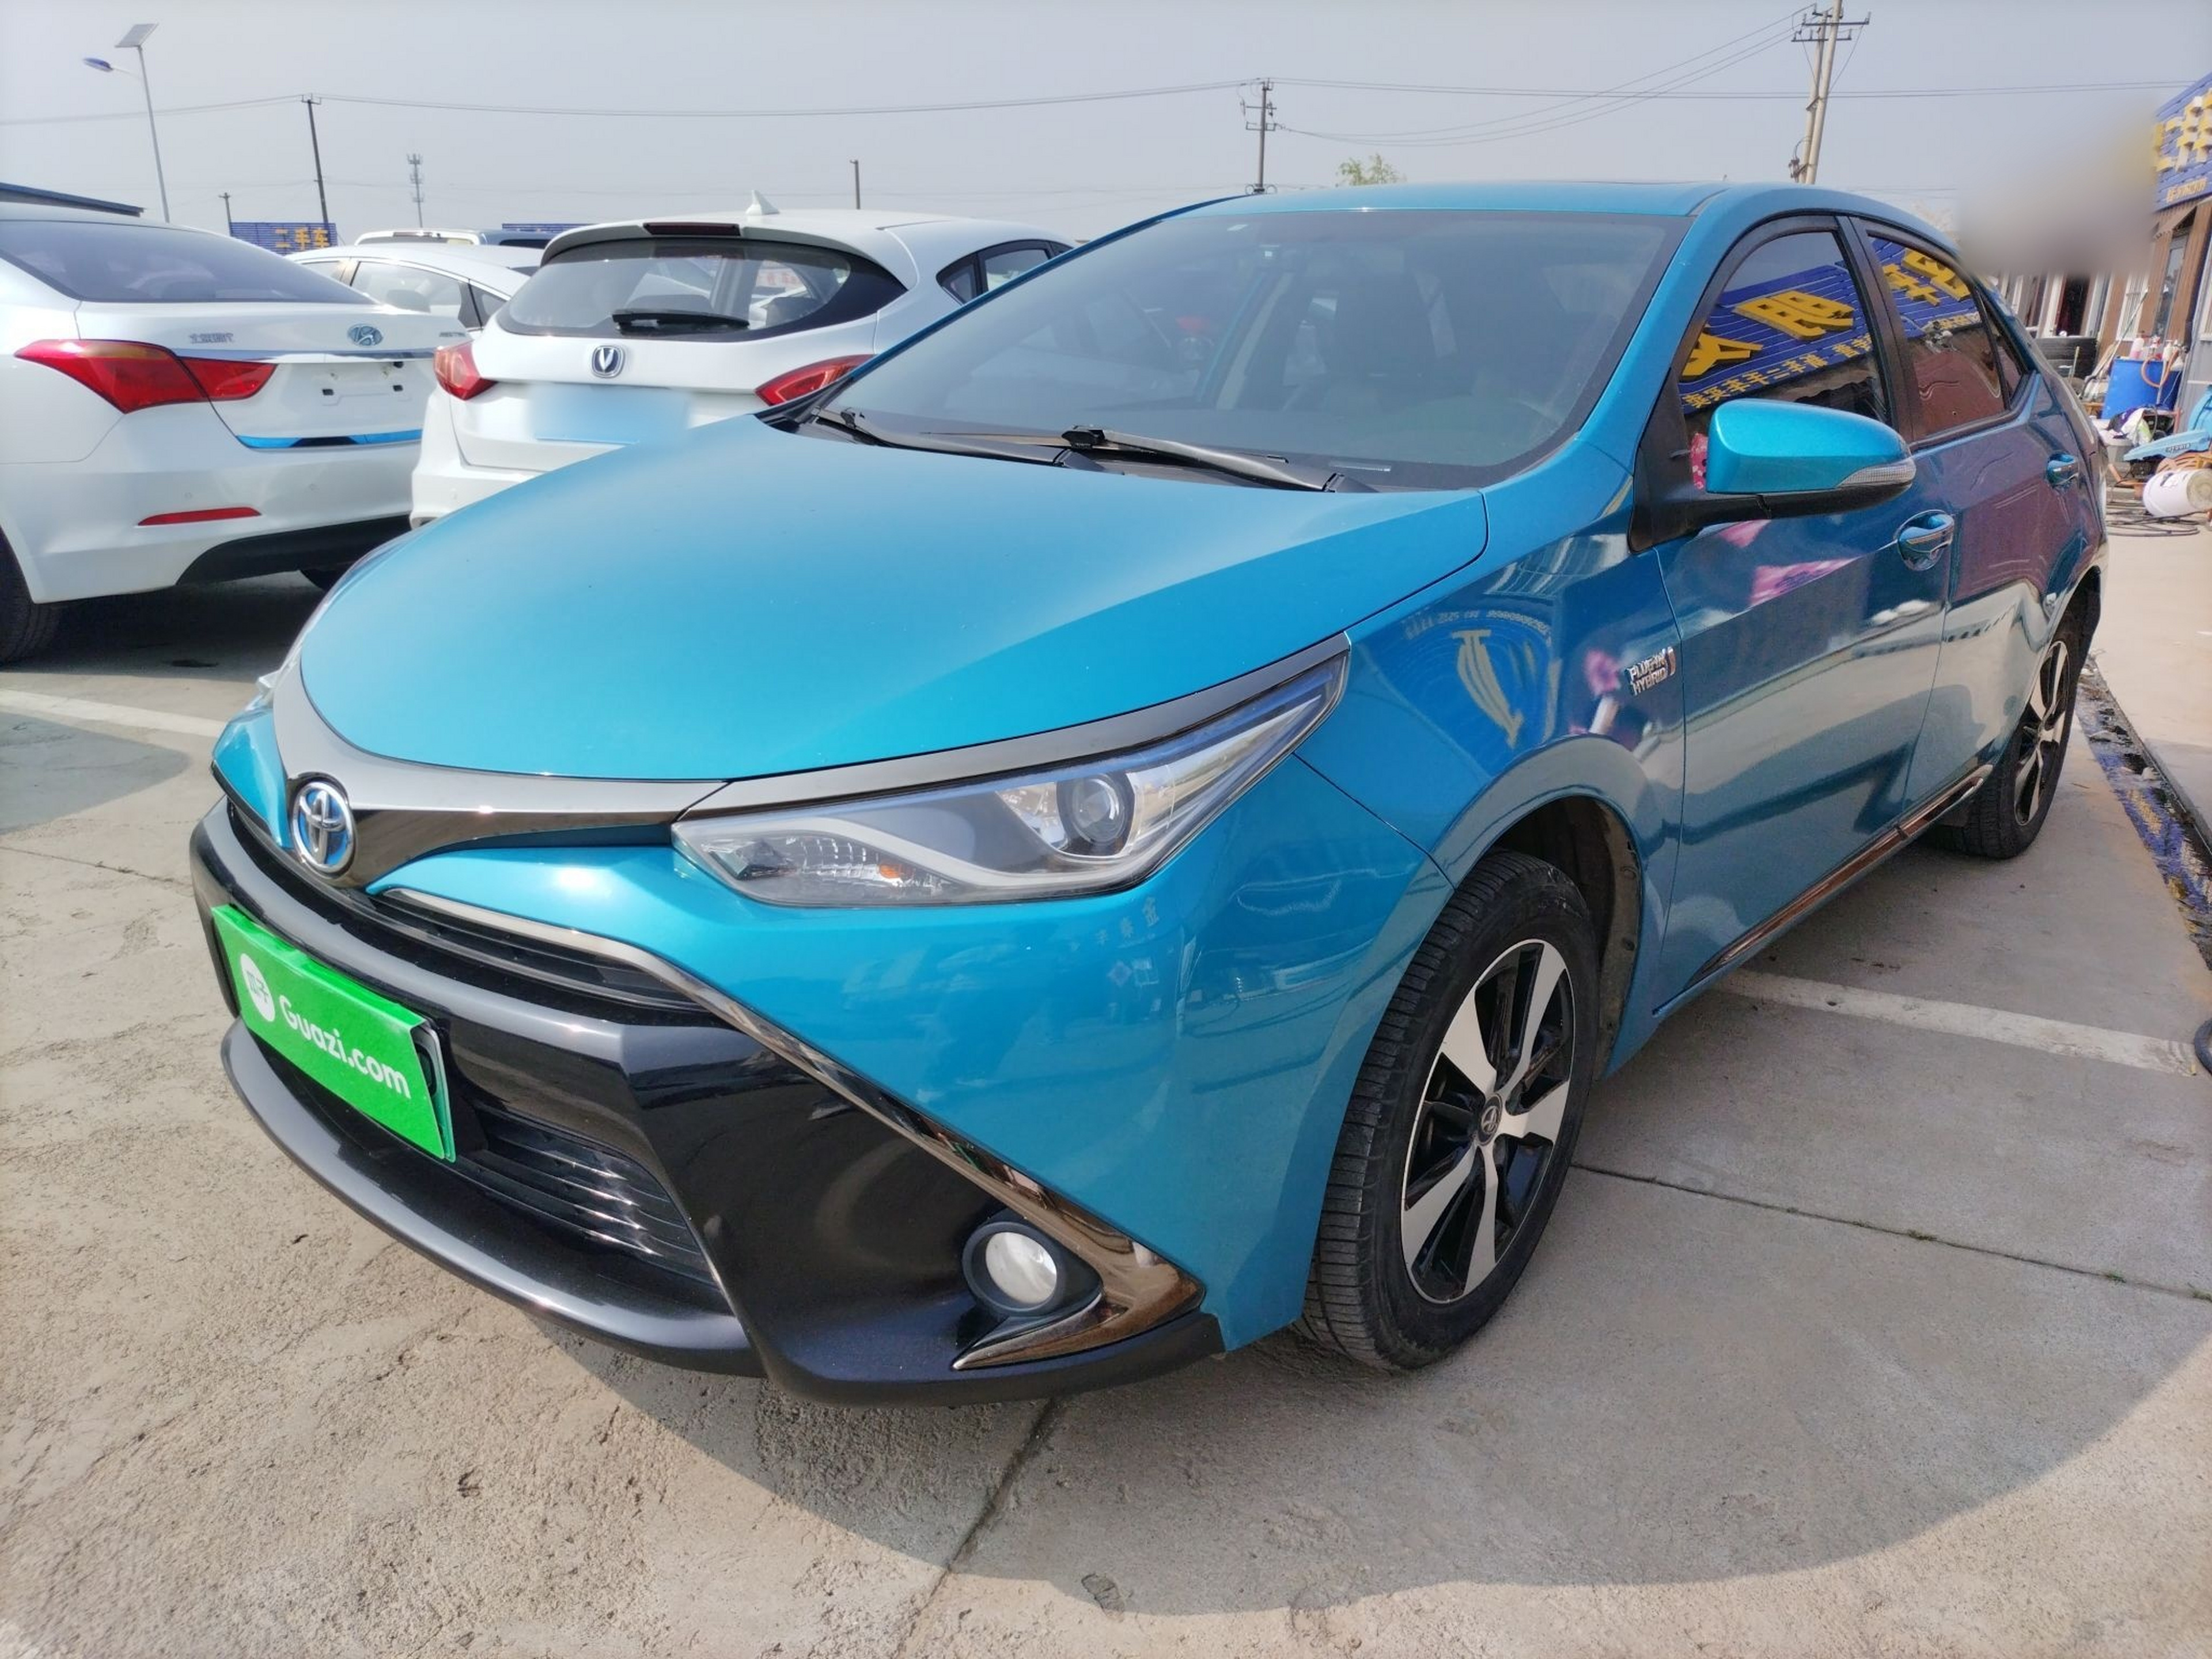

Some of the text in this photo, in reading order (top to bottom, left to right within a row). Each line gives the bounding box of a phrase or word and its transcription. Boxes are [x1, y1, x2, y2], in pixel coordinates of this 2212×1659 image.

[275, 227, 330, 250] 二手车
[1630, 667, 1668, 696] HYBRID
[279, 995, 411, 1099] Guazi.com
